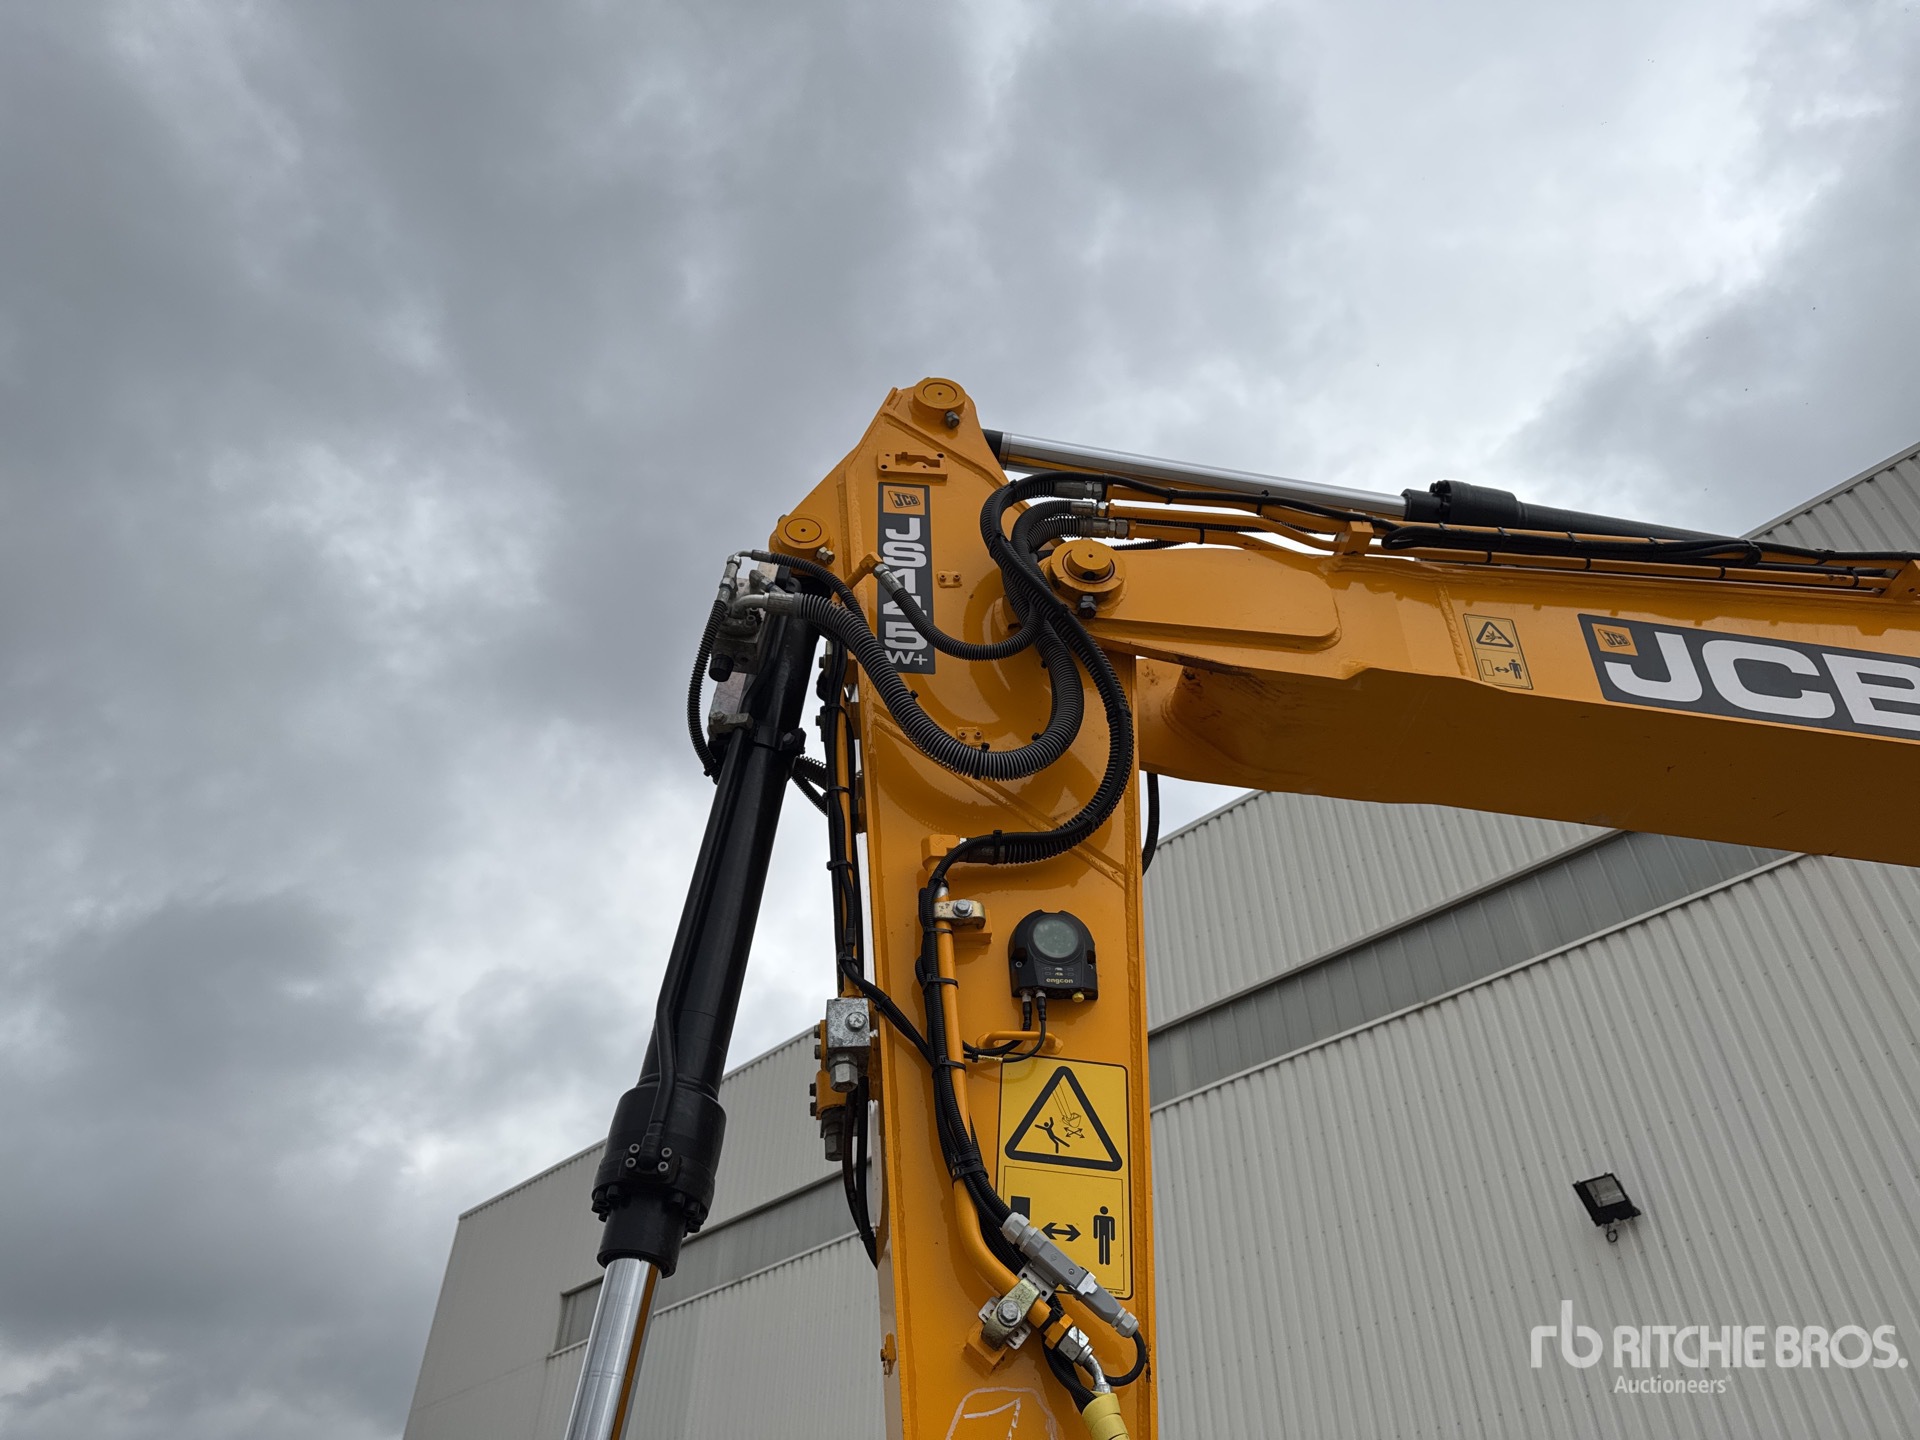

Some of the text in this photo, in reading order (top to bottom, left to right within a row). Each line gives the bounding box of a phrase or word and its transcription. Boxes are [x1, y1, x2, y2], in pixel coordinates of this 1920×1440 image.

[894, 493, 918, 506] JCB
[1604, 632, 1627, 645] JCB
[1604, 632, 1920, 731] JCB
